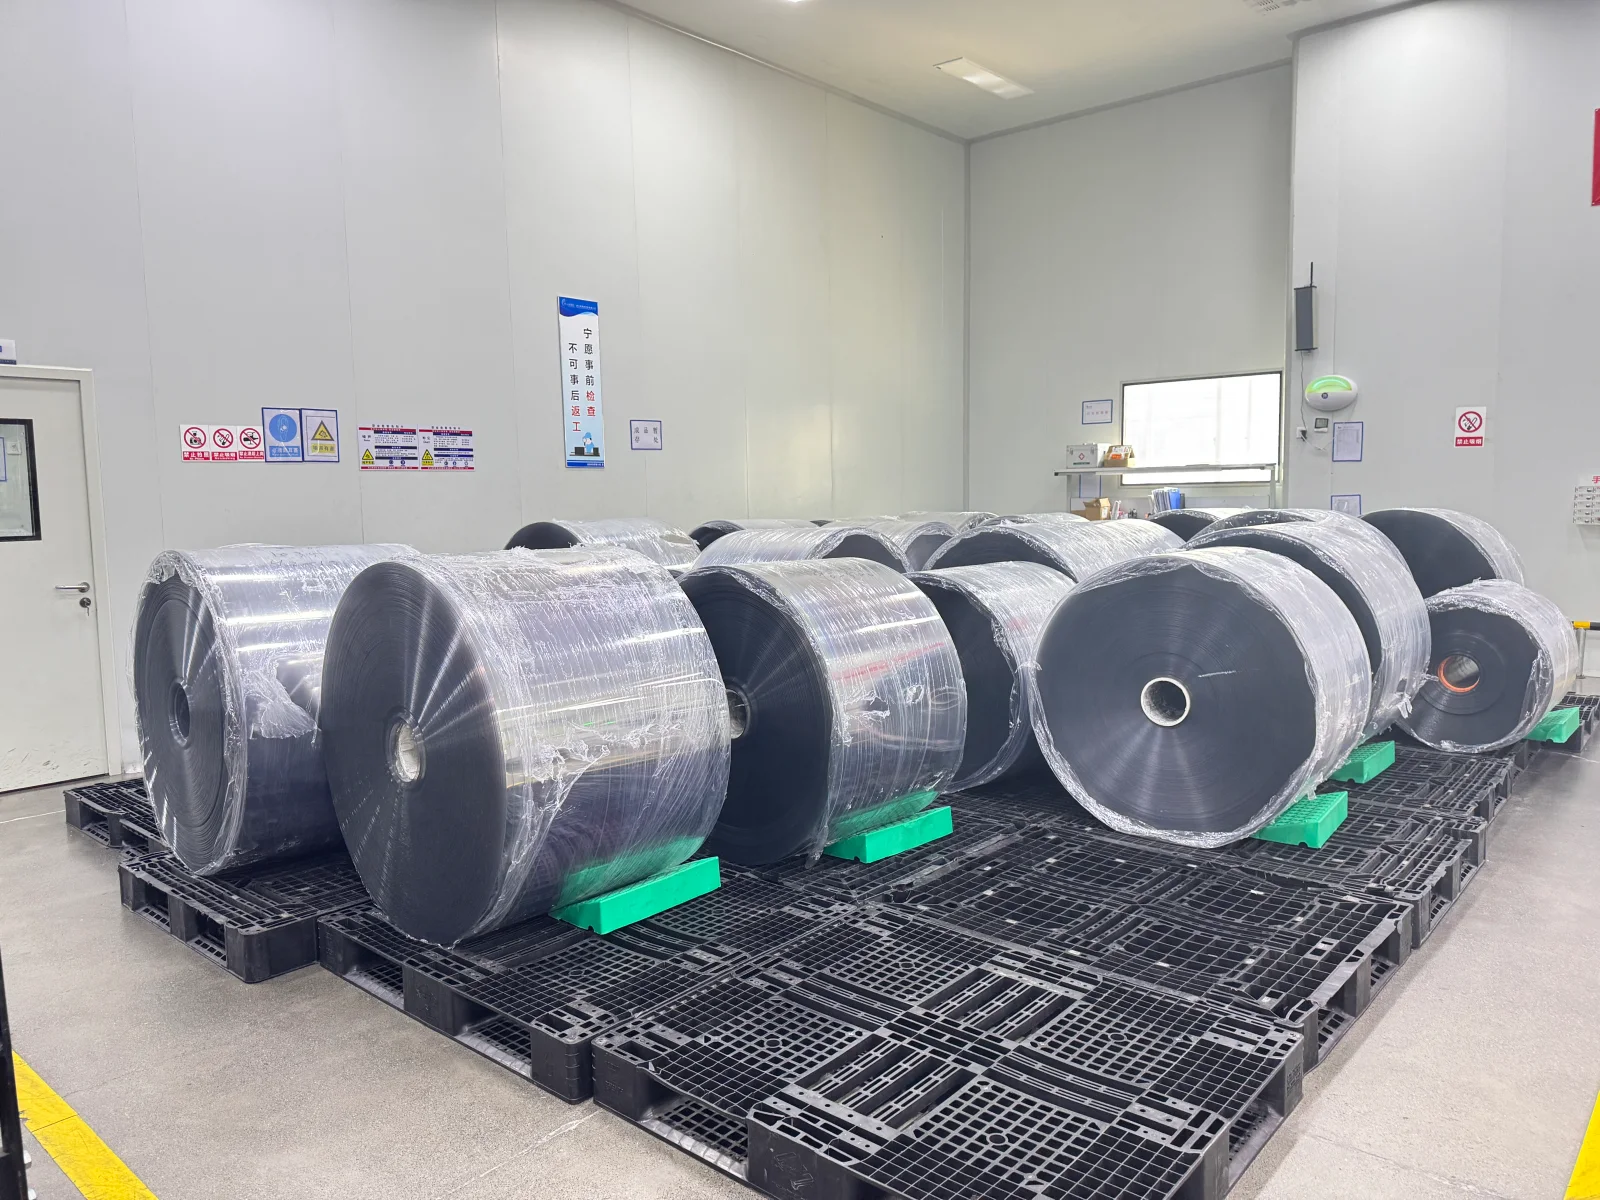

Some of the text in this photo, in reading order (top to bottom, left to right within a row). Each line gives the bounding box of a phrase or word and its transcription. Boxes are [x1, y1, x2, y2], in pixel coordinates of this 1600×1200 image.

[568, 342, 581, 432] 不可事后返工
[583, 328, 596, 417] 宁愿事前检查
